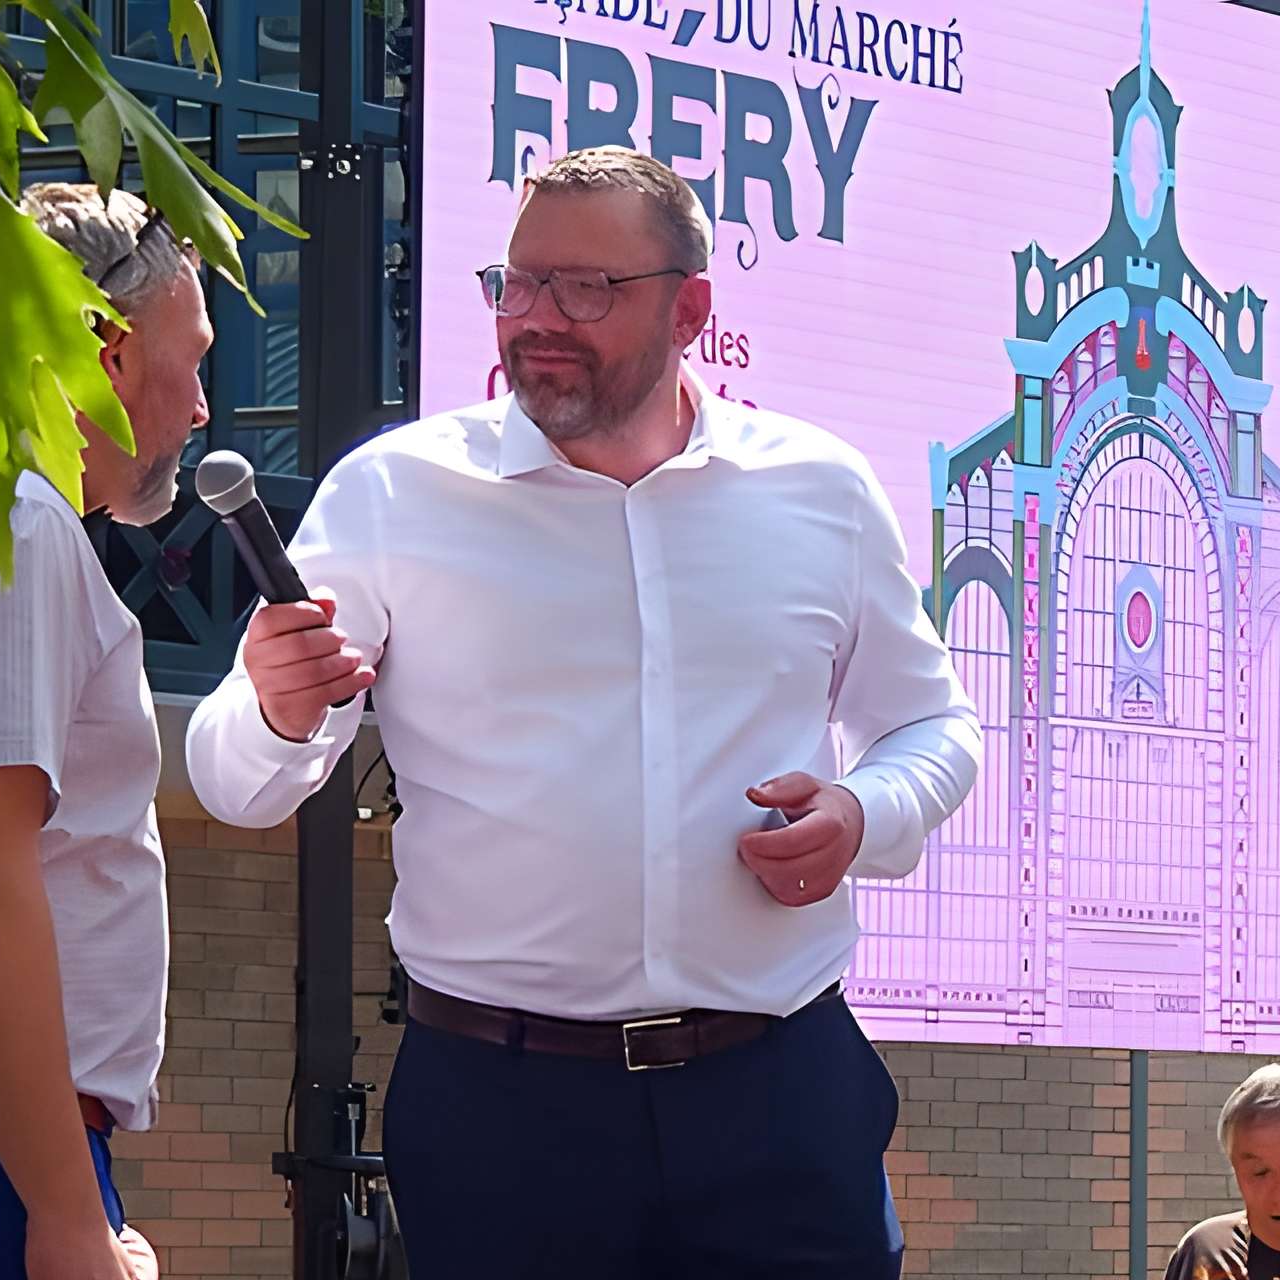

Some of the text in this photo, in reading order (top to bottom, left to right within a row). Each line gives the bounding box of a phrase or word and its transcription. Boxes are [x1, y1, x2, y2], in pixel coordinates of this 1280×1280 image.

[714, 0, 771, 51] DU
[787, 0, 964, 94] MARCHÉ
[488, 8, 880, 270] FRÉRY
[700, 313, 750, 370] des
